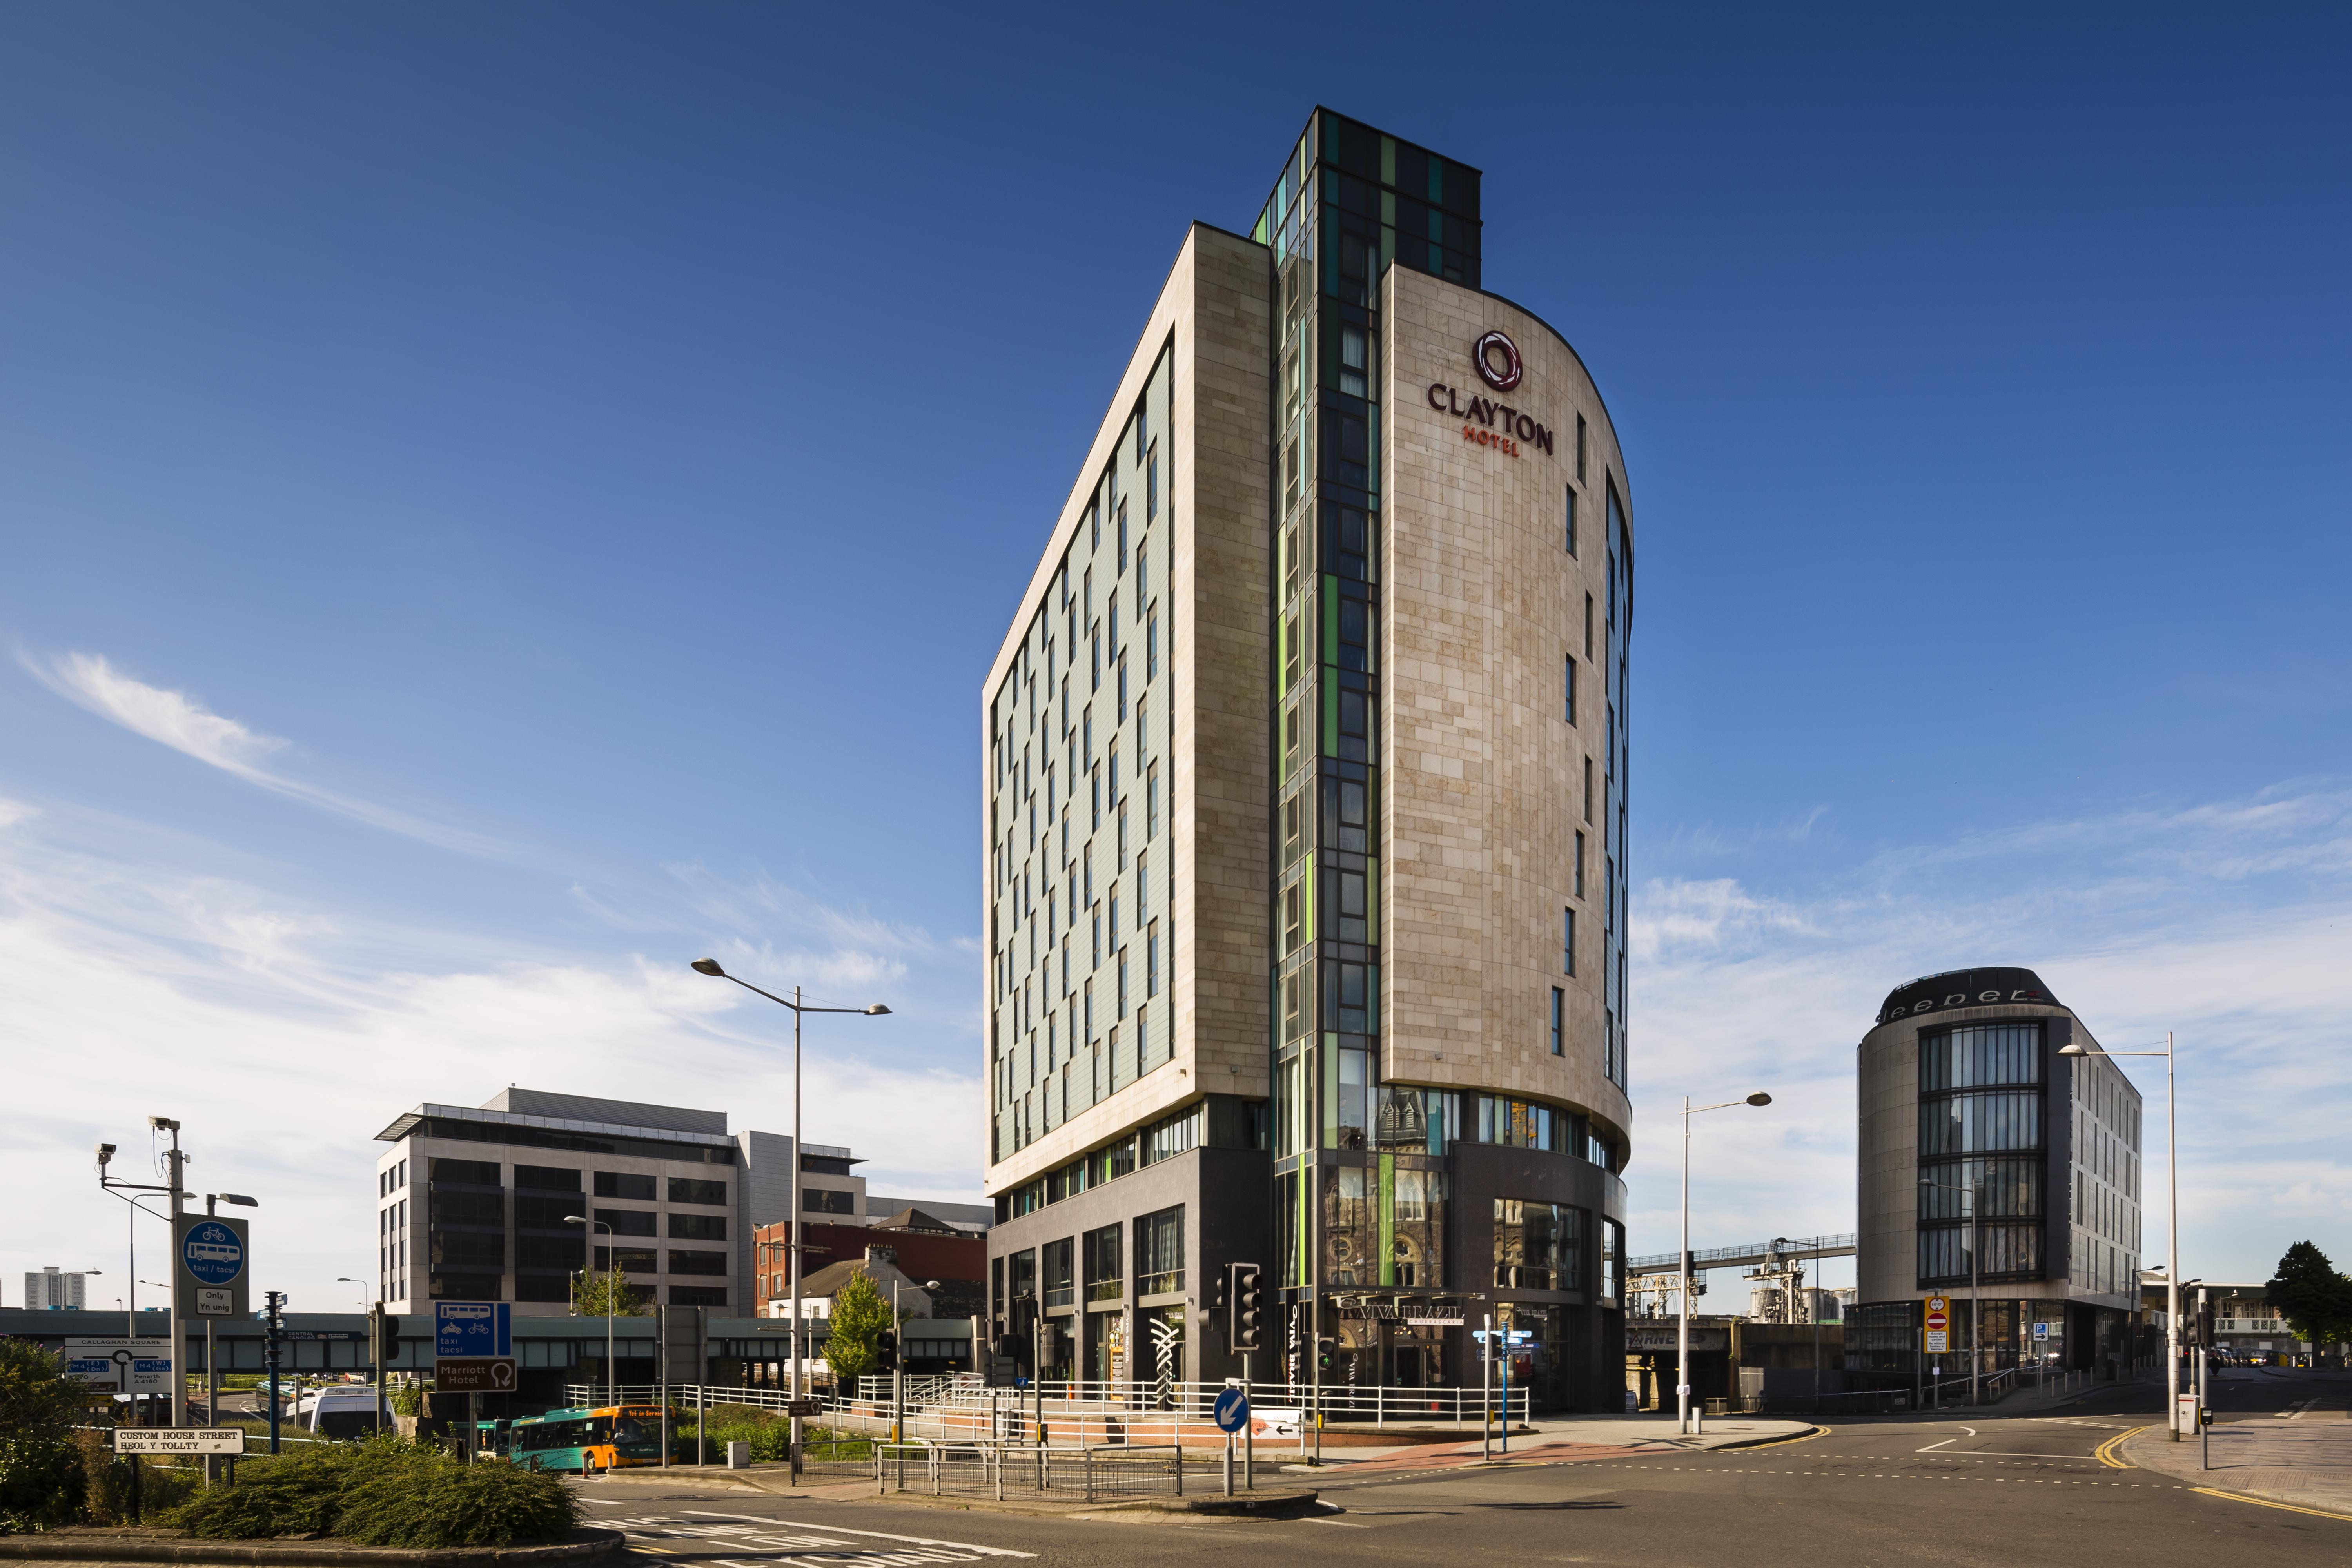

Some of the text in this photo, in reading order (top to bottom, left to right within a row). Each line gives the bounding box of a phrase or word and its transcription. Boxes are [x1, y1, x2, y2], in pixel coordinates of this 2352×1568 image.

[1427, 383, 1553, 456] CLAYTON
[1463, 425, 1520, 457] HOTEL
[206, 1292, 224, 1300] Only
[1402, 1305, 1465, 1319] BRAZIL
[1349, 1353, 1358, 1381] VIVA
[582, 1517, 693, 1529] BUS
[624, 1525, 788, 1540] LANE
[707, 1535, 860, 1551] LÔN
